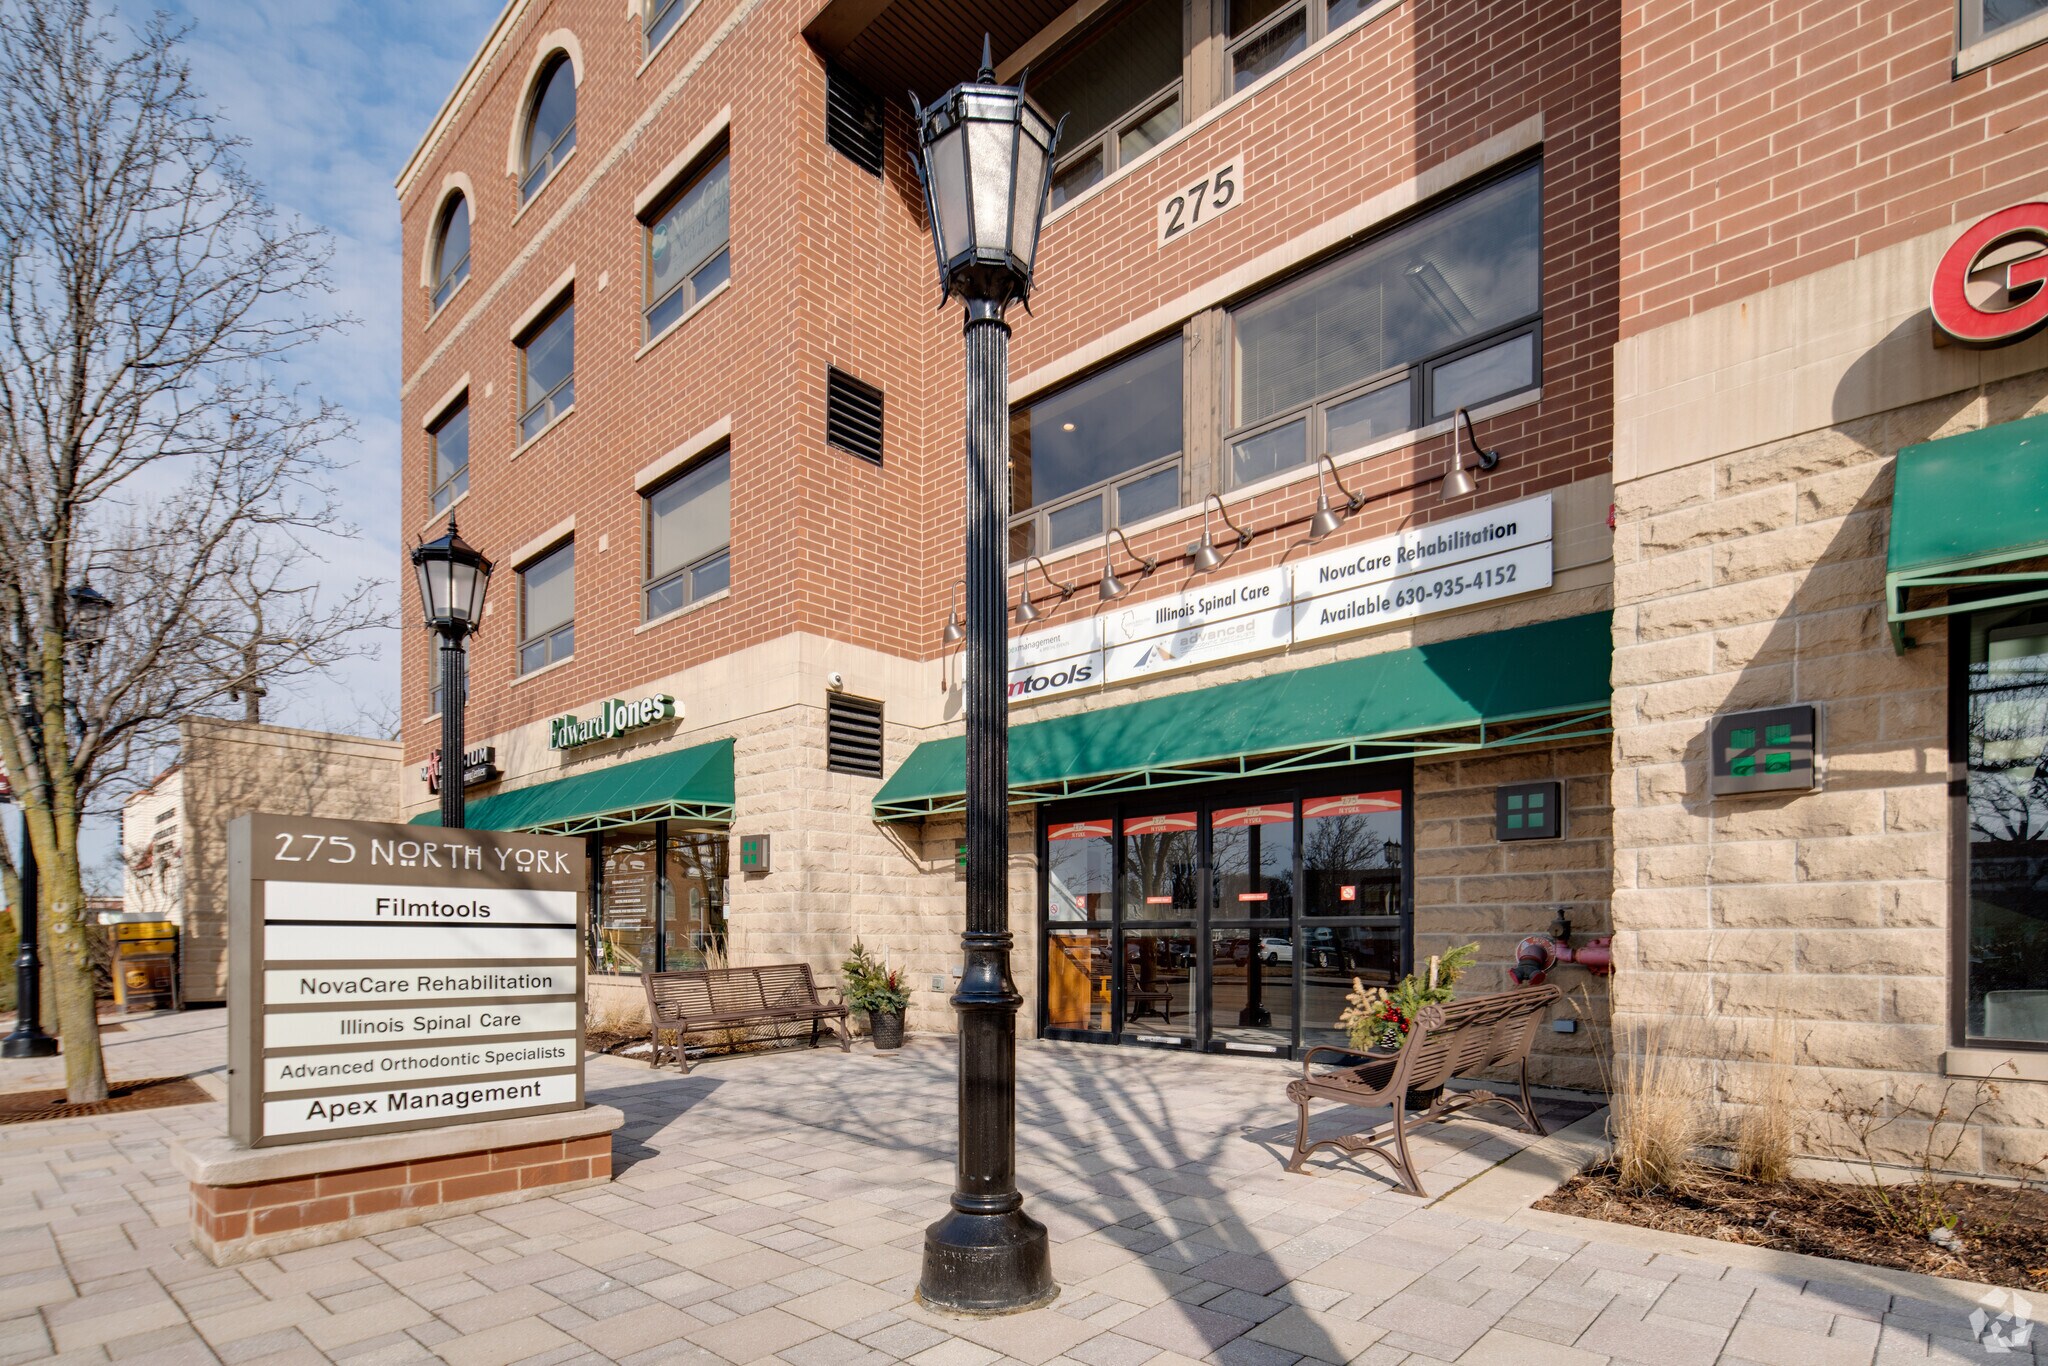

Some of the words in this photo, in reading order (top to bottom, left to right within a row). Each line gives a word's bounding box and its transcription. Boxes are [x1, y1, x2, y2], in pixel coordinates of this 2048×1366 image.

[1164, 164, 1235, 240] 275
[1319, 553, 1391, 584] NovaCare
[1397, 521, 1517, 564] Rehabilitation
[1156, 604, 1195, 625] Illinois
[1198, 588, 1236, 616] Spinal
[1240, 584, 1270, 602] Care
[1320, 594, 1390, 626] Available
[1396, 563, 1517, 608] 630-935-4152
[1179, 618, 1256, 647] advanced
[274, 832, 357, 864] 275
[370, 838, 482, 871] NORTH
[494, 846, 571, 875] YORK
[375, 897, 491, 918] Filmtools
[299, 976, 410, 996] NovaCare
[416, 973, 553, 992] Rehabilitation
[340, 1017, 404, 1035] Illinois
[412, 1014, 471, 1034] Spinal
[479, 1012, 522, 1027] Care
[279, 1058, 375, 1080] Advanced
[380, 1052, 480, 1072] Orthodontic
[484, 1046, 566, 1066] Specialists
[305, 1099, 379, 1123] Apex
[386, 1080, 541, 1112] Management
